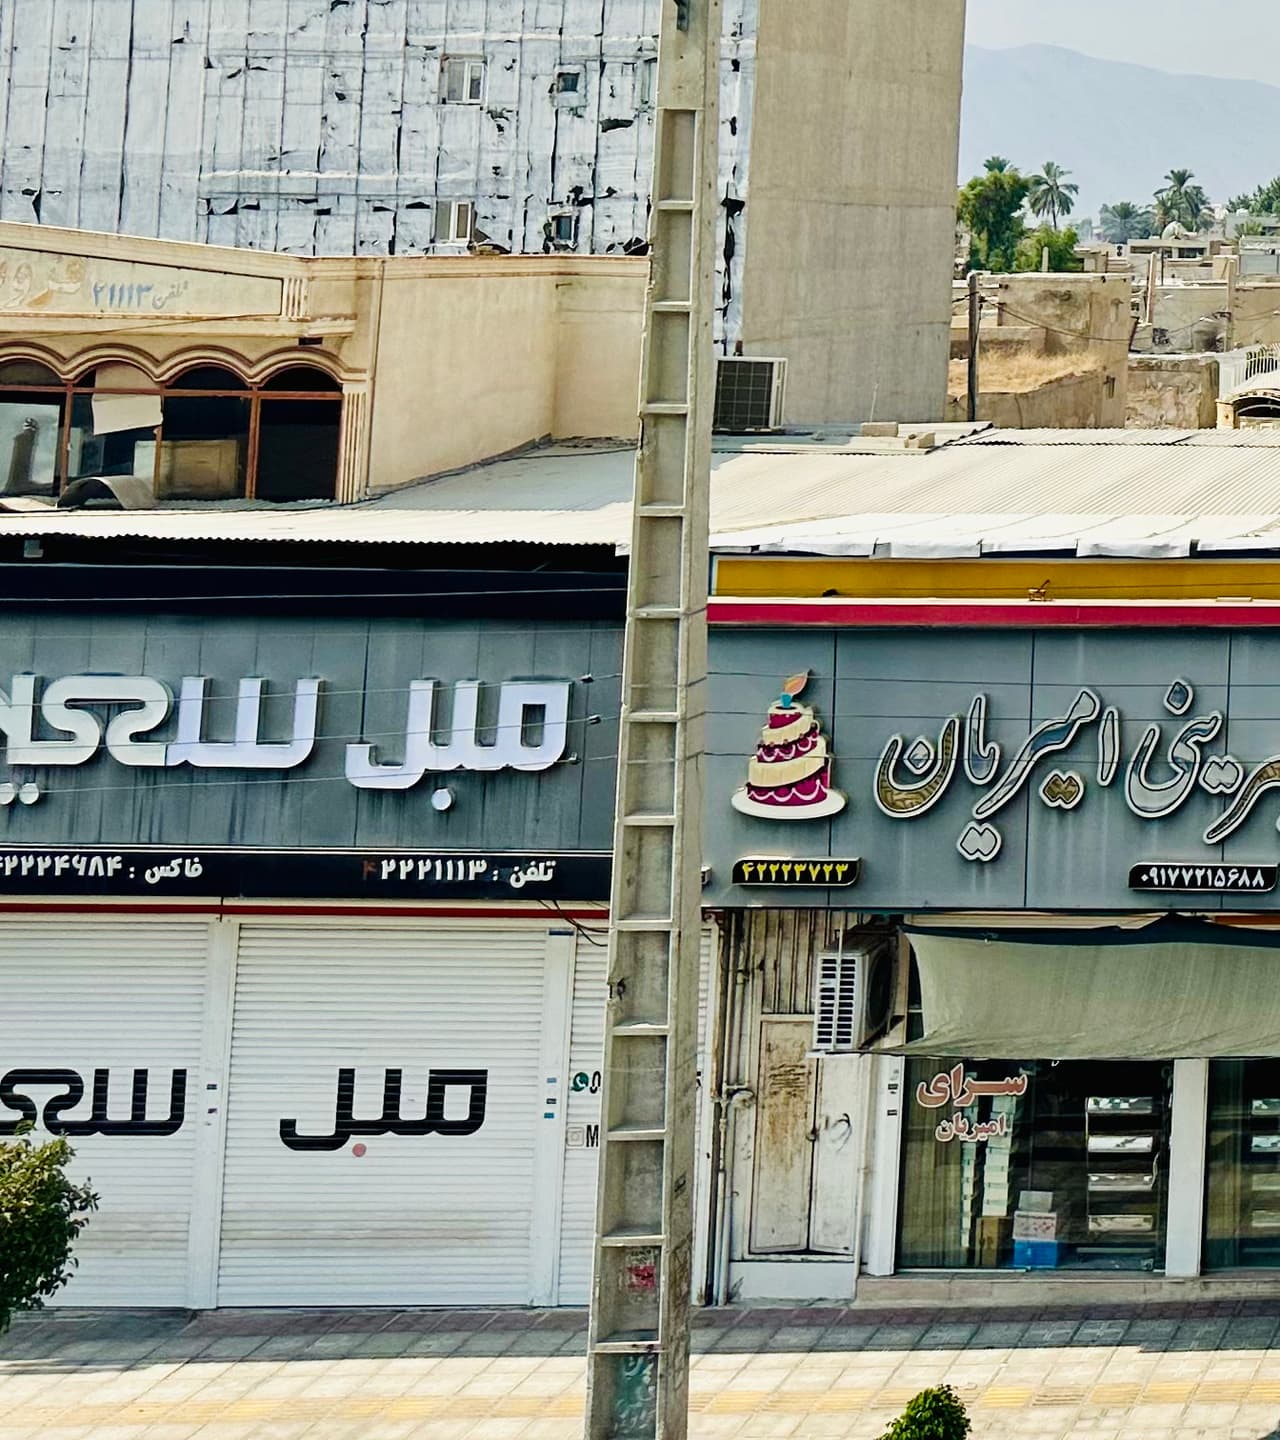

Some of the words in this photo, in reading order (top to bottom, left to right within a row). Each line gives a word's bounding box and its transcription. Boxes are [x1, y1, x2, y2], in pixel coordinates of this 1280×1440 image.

[345, 677, 576, 812] مبل
[144, 856, 204, 885] فاکس
[508, 859, 557, 889] تلفن
[741, 861, 849, 882] ۴۲۲۲۳۷۲۳
[1140, 866, 1265, 888] ۰۹۱۷۷۲۱۵۶۸۸
[916, 1062, 1028, 1109] سرای
[280, 1068, 488, 1152] مبل
[935, 1111, 1009, 1143] امیریان
